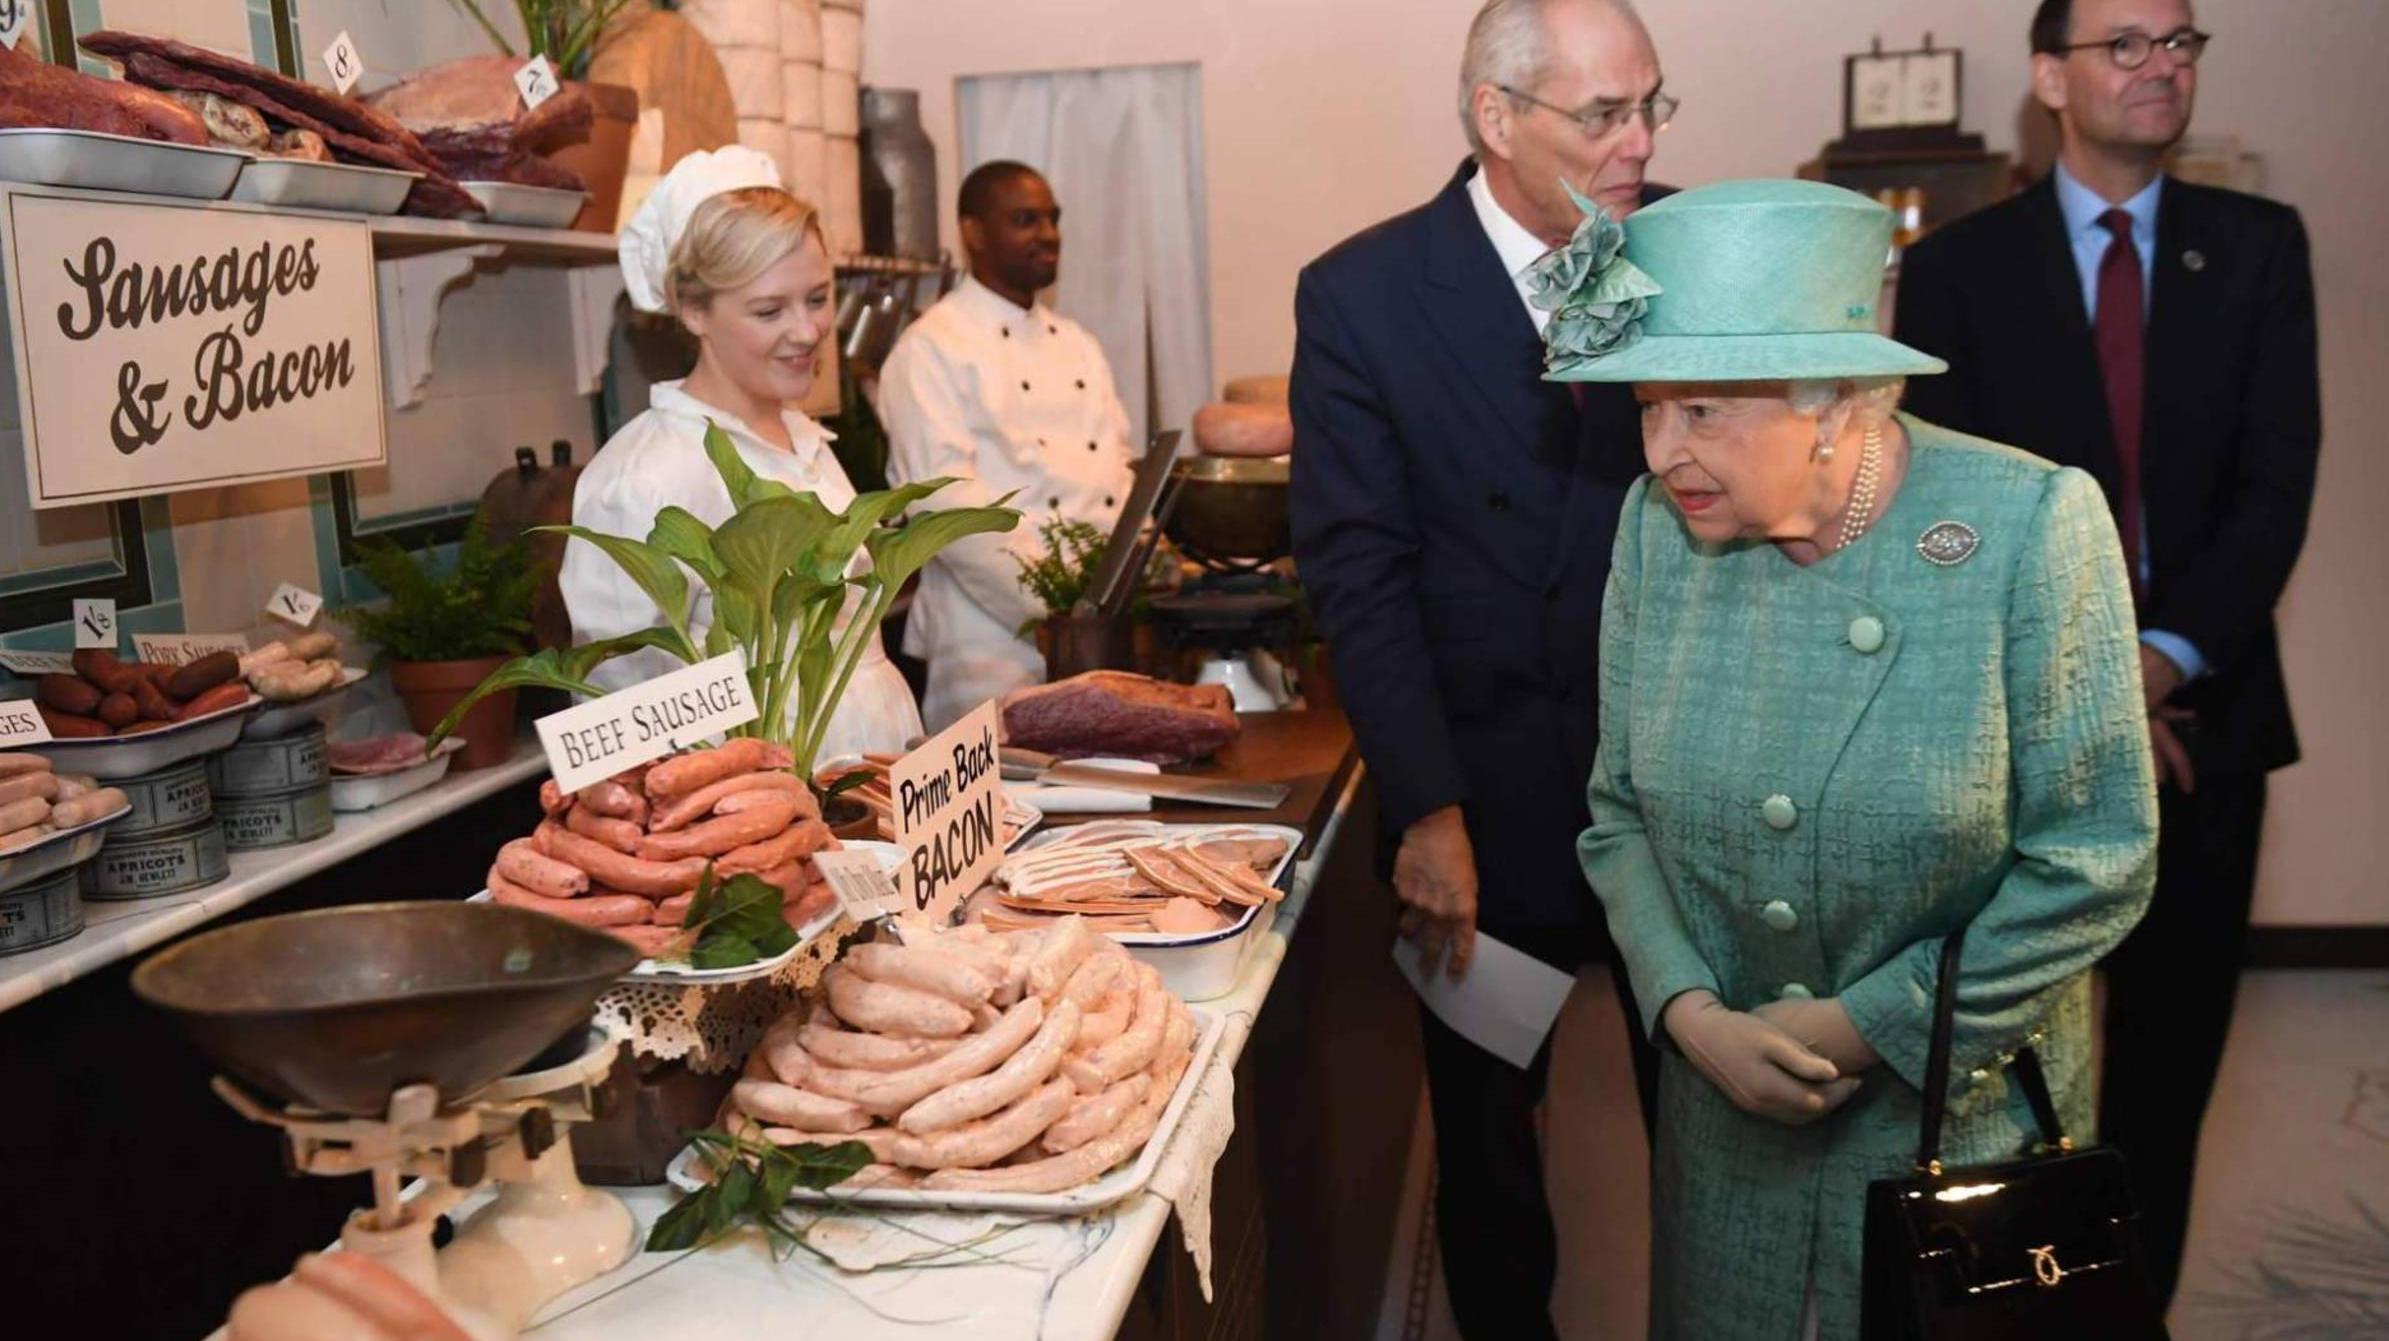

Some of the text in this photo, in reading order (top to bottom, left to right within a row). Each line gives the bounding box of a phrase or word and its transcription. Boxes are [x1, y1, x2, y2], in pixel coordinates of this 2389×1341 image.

[57, 236, 320, 341] Sausages
[110, 323, 355, 455] & Bacon
[560, 676, 741, 769] BEEF SAUSAGE
[900, 725, 994, 835] Prime Back
[107, 854, 185, 873] APRICOTS
[912, 790, 994, 911] BACON
